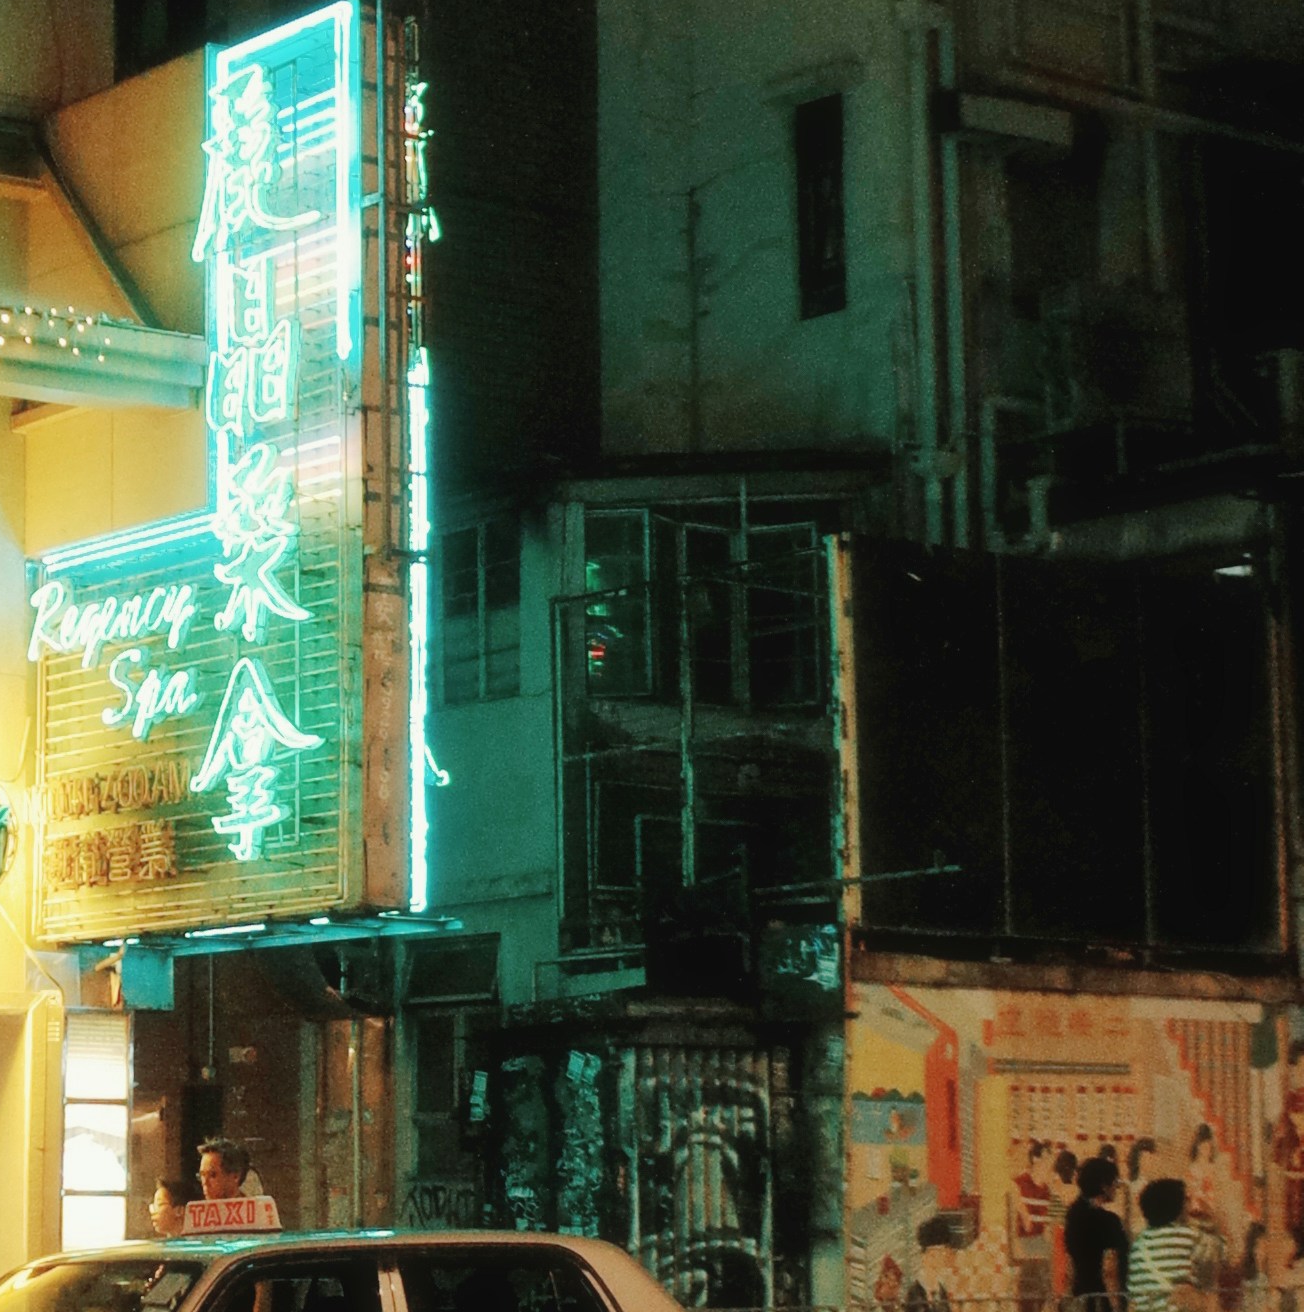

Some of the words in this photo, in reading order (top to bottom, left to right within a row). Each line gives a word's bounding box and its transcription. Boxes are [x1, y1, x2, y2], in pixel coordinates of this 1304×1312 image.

[27, 581, 196, 667] Regency
[101, 649, 198, 738] Spa
[188, 1199, 257, 1228] TAXI
